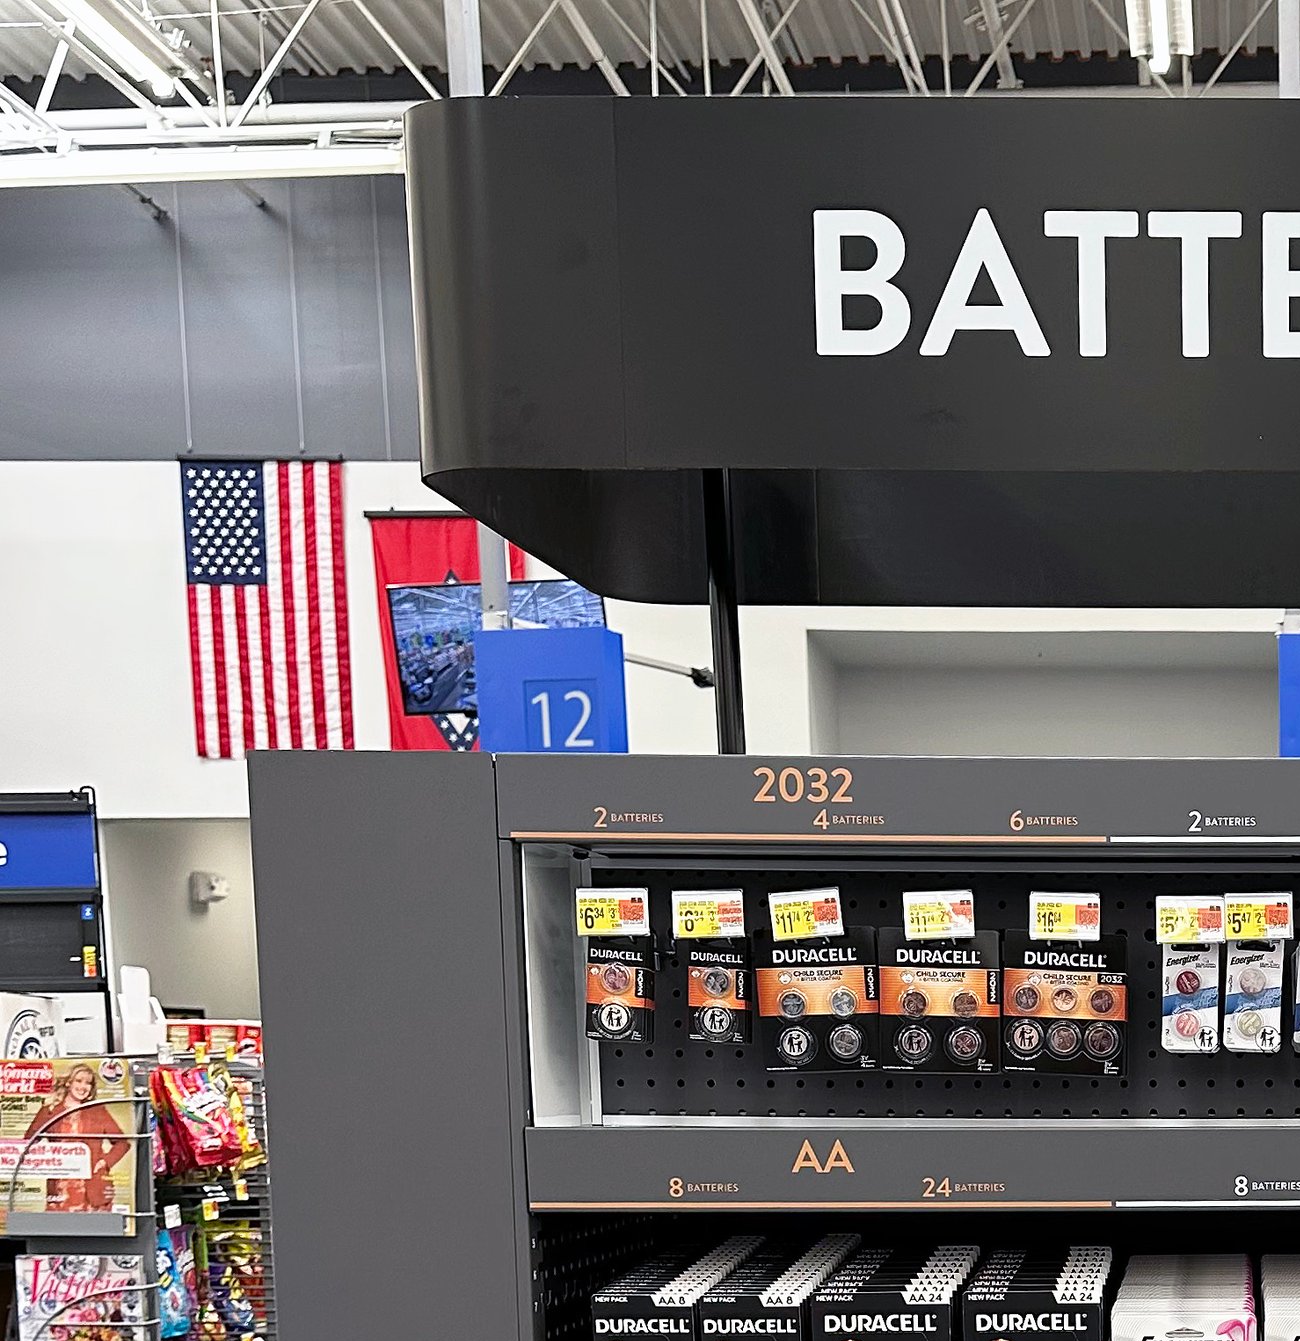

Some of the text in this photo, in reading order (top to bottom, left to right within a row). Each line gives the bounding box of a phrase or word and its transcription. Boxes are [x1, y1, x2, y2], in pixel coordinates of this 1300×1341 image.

[531, 690, 595, 749] 12
[753, 766, 854, 803] 2032
[593, 806, 664, 828] 2 BATTERIES
[812, 808, 885, 830] 4 BATTERIES
[1009, 809, 1079, 832] 6 BATTERIES
[772, 948, 857, 963] DURACELL
[896, 948, 981, 964] DURACELL
[1024, 951, 1107, 968] DURACELL
[793, 970, 815, 978] CHILD
[1100, 975, 1123, 984] 2032
[791, 1138, 856, 1174] AA
[669, 1177, 740, 1198] 8 BATTERIES
[921, 1177, 1006, 1198] 24 BATTERIES
[816, 1294, 831, 1302] NEW
[909, 1292, 943, 1302] AA 24
[824, 1314, 937, 1333] DURACELL
